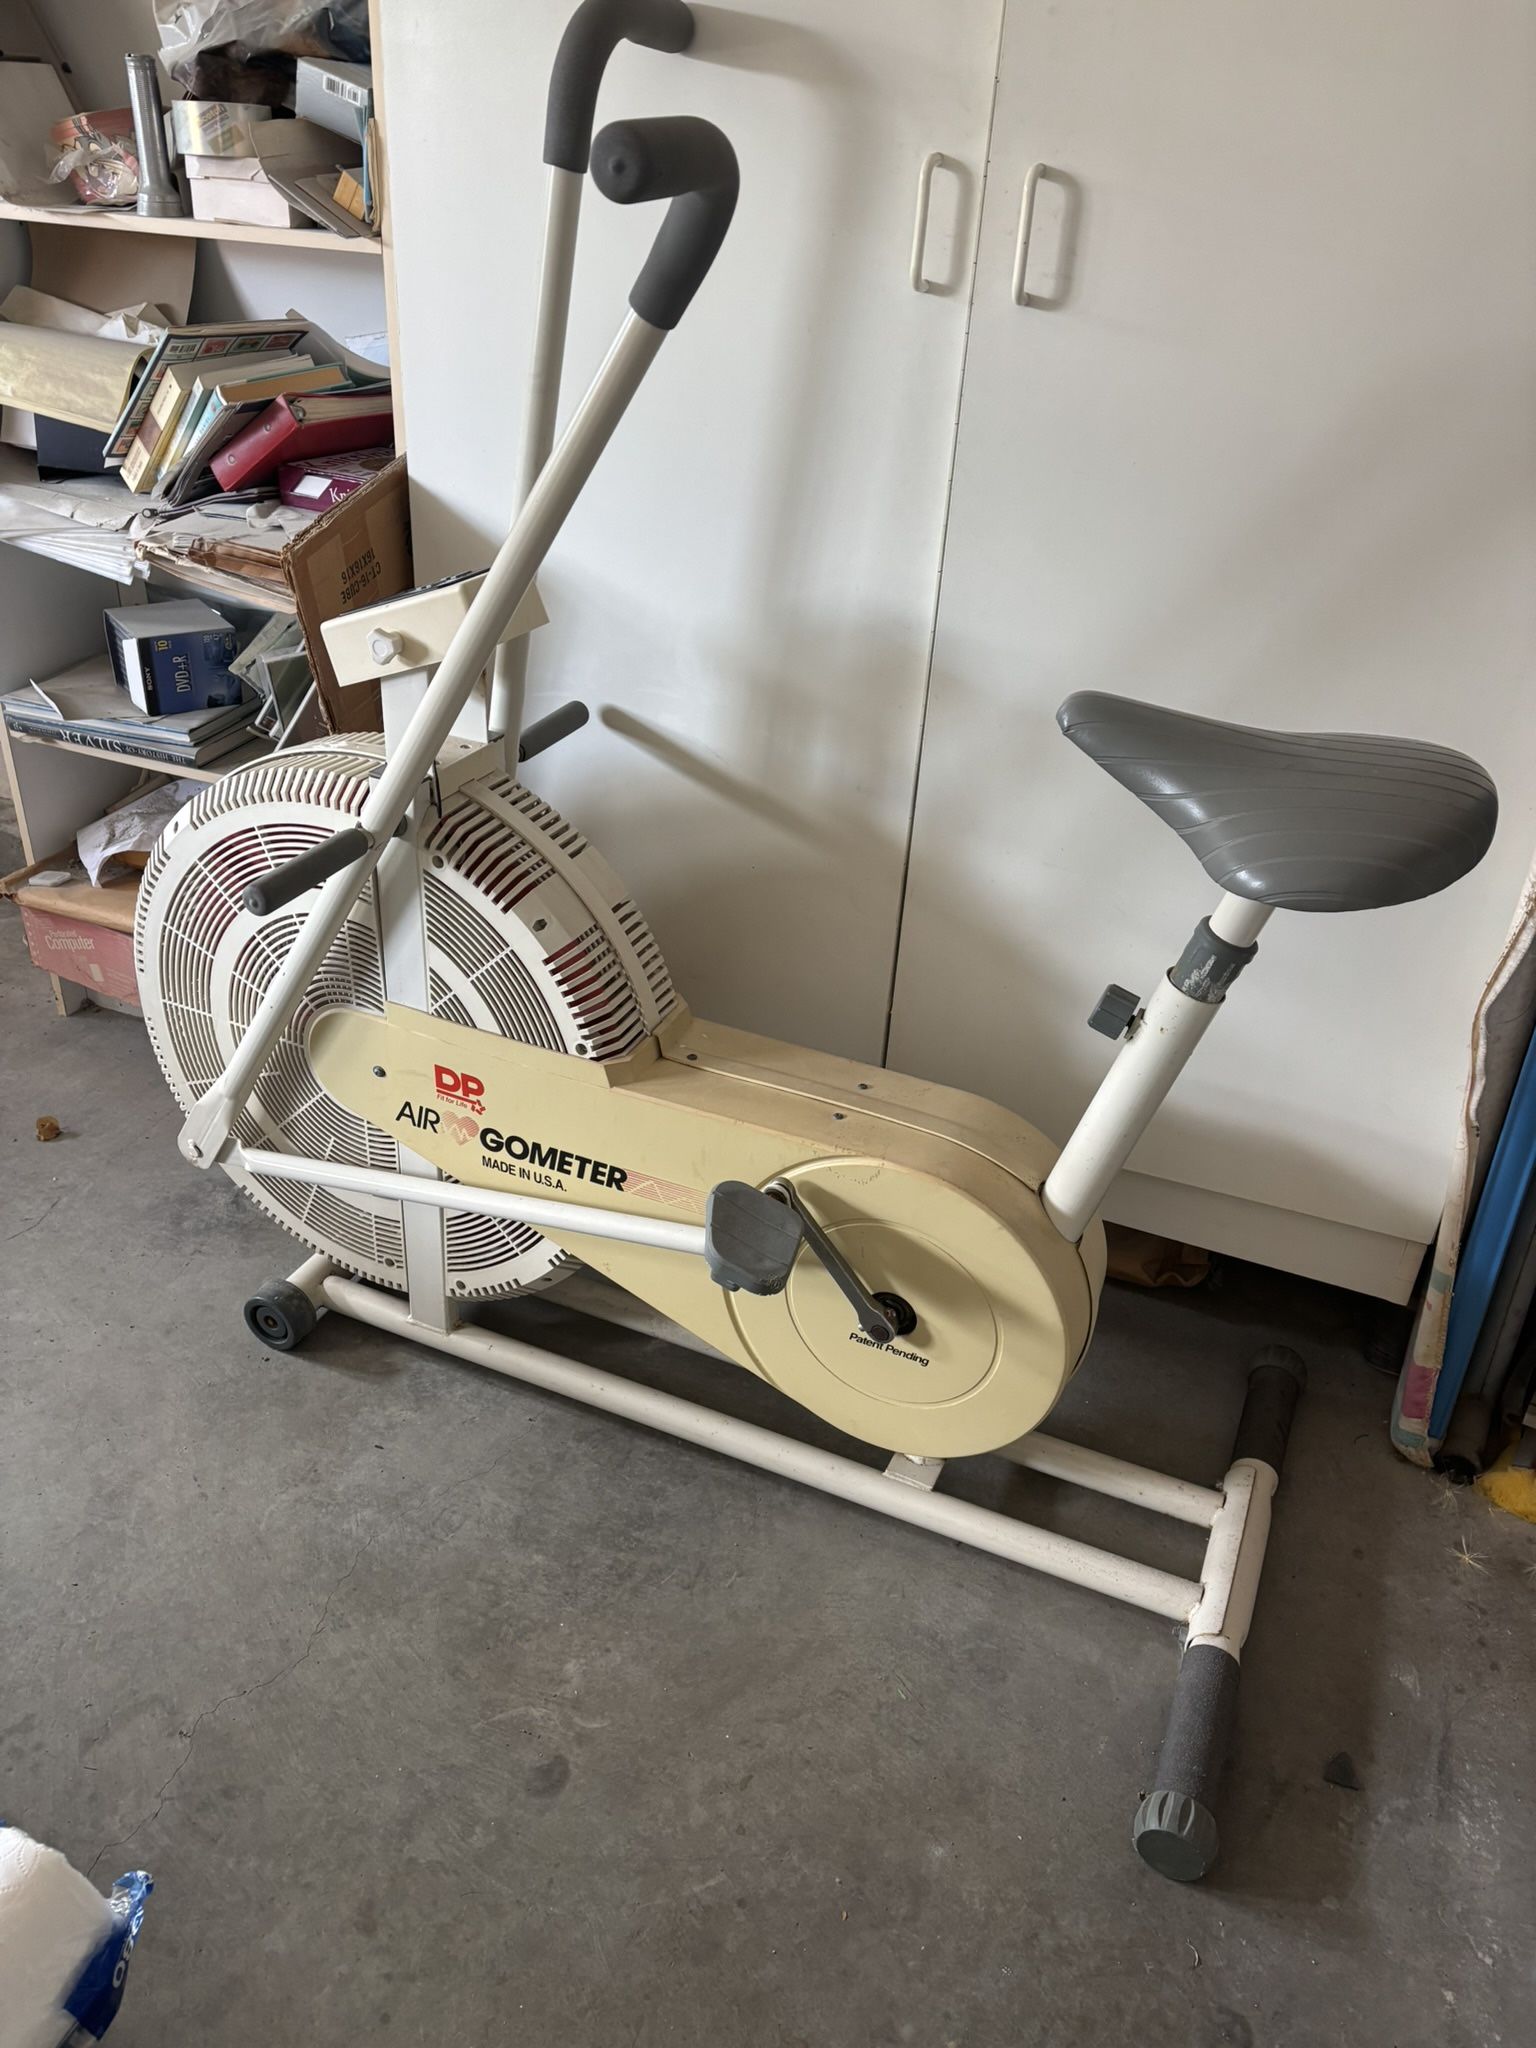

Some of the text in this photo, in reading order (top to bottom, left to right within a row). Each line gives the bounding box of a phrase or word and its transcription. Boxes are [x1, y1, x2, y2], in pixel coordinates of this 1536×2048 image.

[157, 640, 169, 652] 10
[144, 666, 153, 691] SONY
[172, 655, 191, 693] DVD+R
[59, 729, 123, 754] SILVER
[45, 936, 95, 952] Computer
[433, 1063, 485, 1098] DP
[446, 1096, 455, 1104] for
[456, 1098, 468, 1109] Life
[395, 1100, 628, 1192] AIR GOMETER
[482, 1155, 567, 1192] MADE IN U.S.A.
[849, 1332, 930, 1367] Patent Pending
